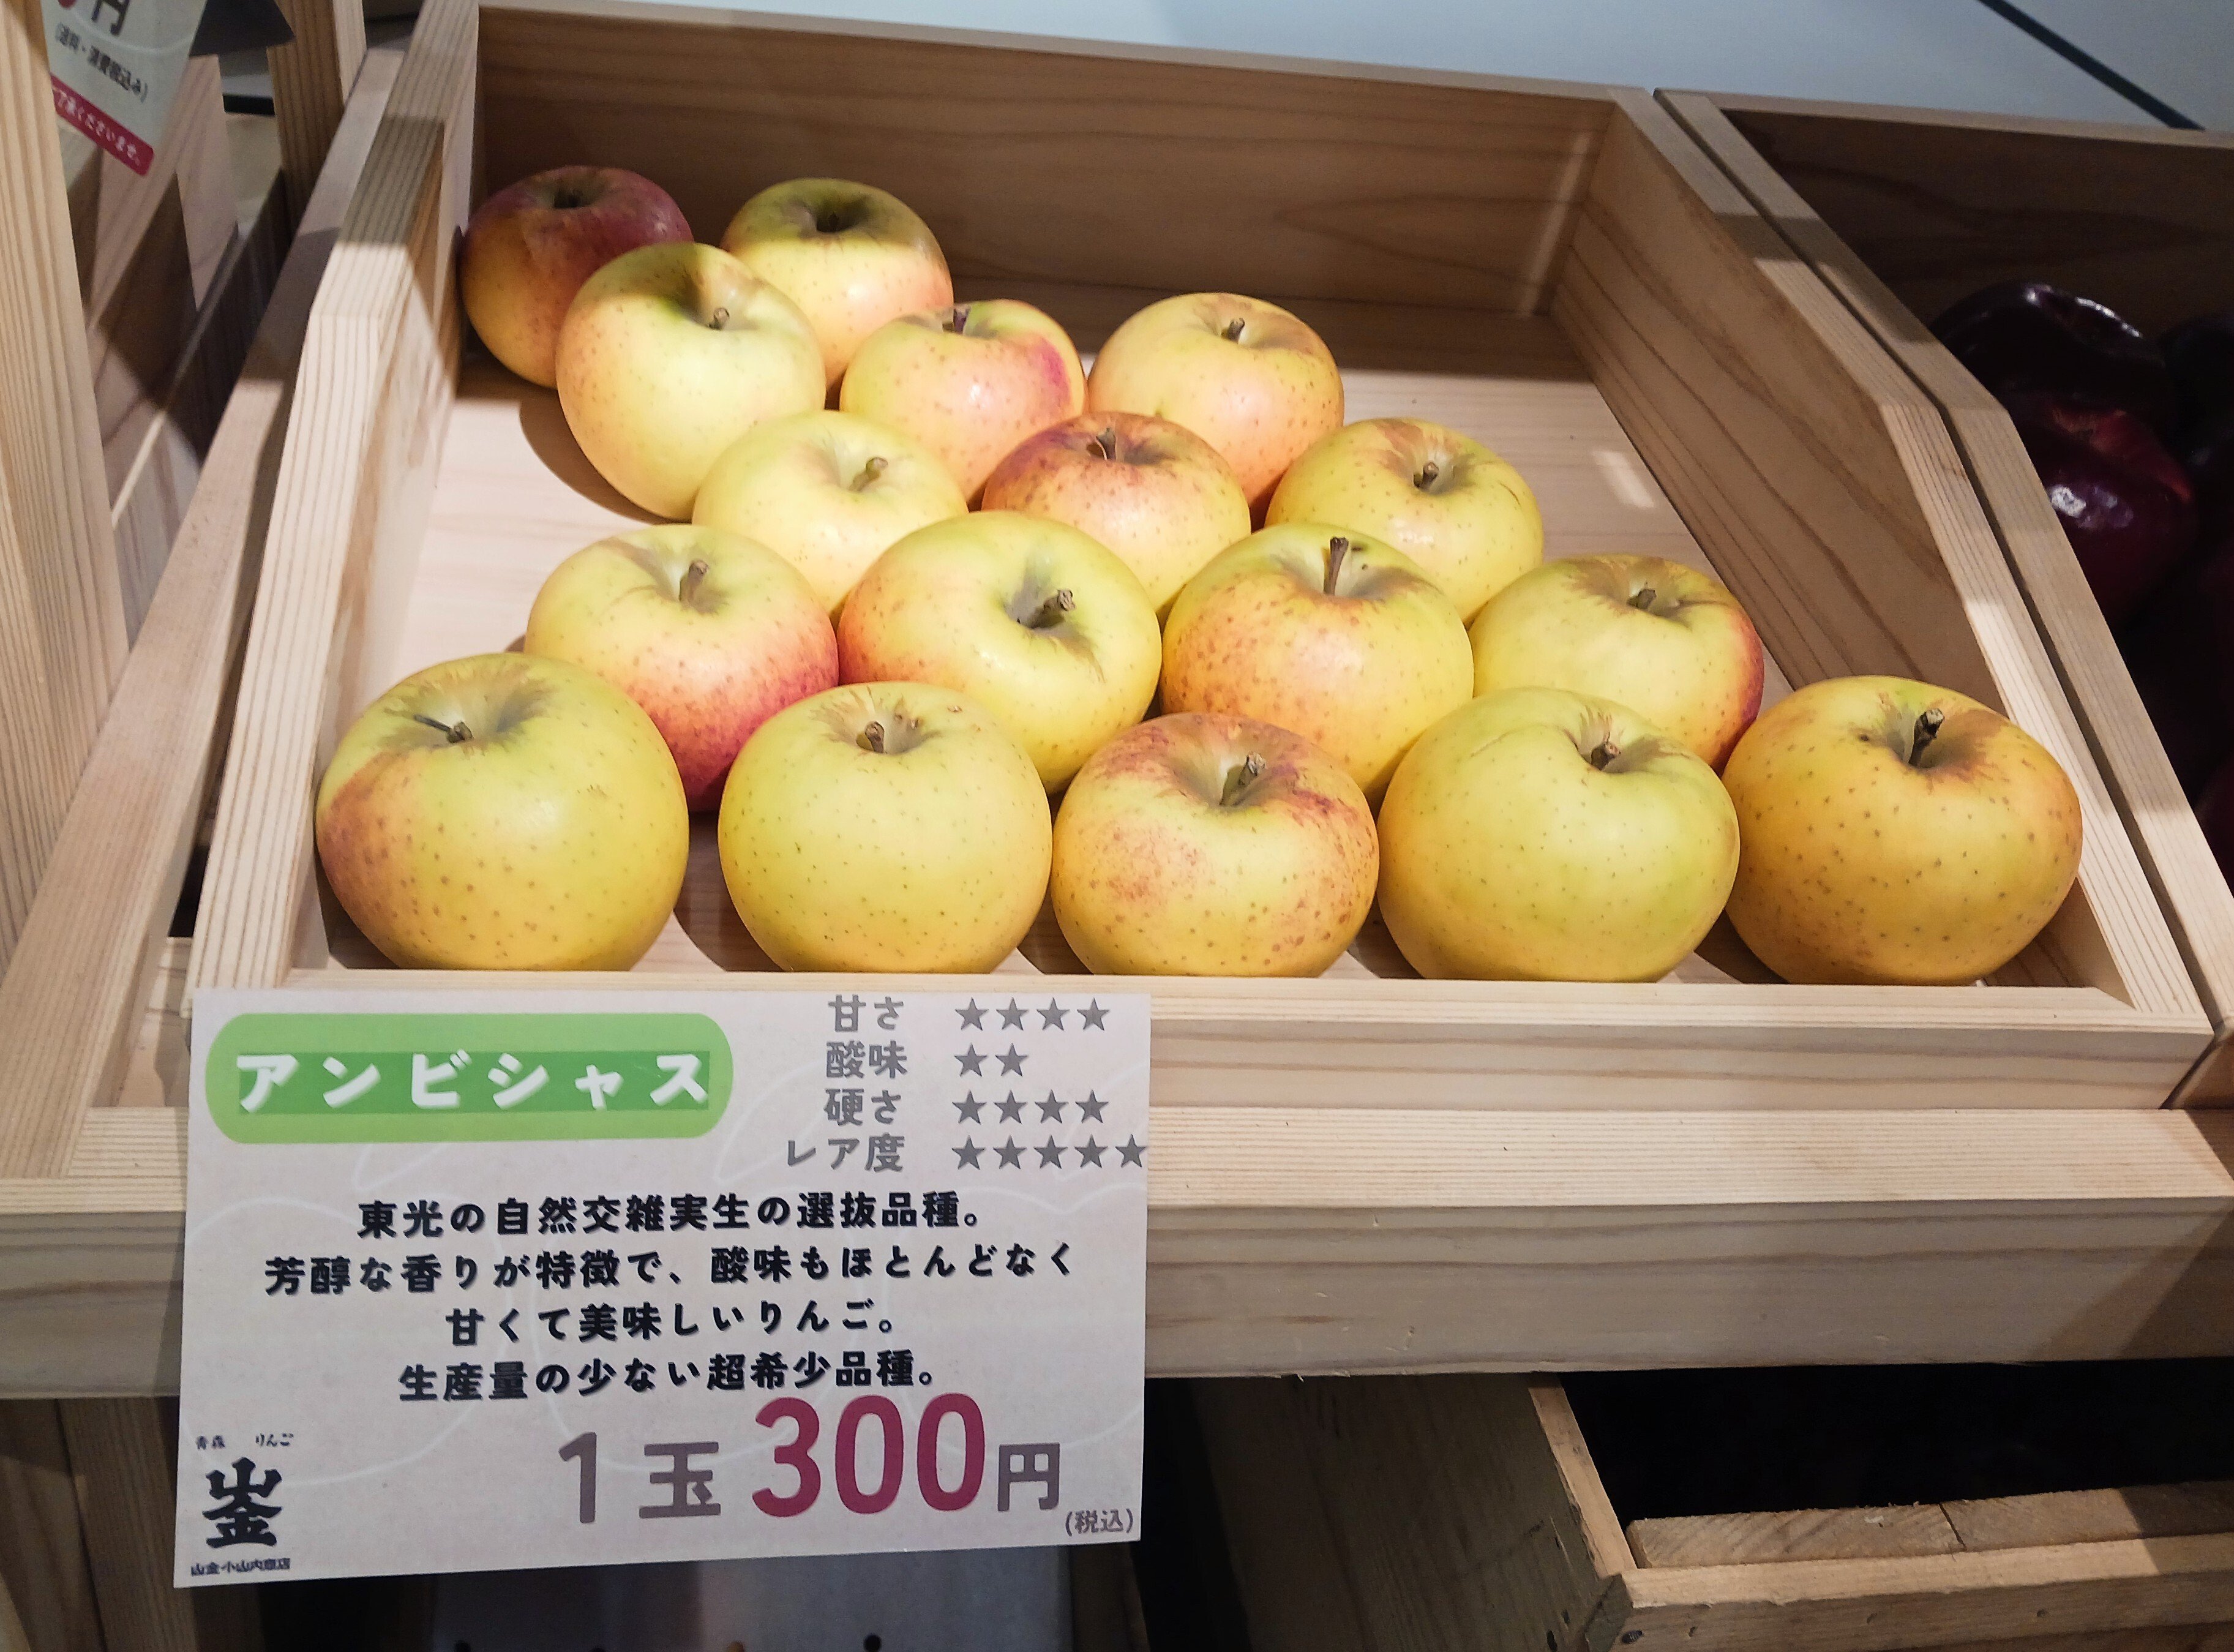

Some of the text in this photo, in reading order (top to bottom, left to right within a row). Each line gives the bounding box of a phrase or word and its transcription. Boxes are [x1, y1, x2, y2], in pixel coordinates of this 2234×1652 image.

[828, 994, 904, 1033] 甘さ
[827, 1040, 907, 1079] 酸味
[236, 1049, 707, 1113] アンビシャス
[823, 1087, 902, 1127] 硬さ
[787, 1133, 905, 1173] レア度
[358, 1190, 978, 1239] 東光の自然交雑実生の選抜品種。
[446, 1298, 893, 1347] 甘くて美味しいりんご。
[399, 1349, 933, 1402] 生産量の少ない超希少品種。
[255, 1433, 294, 1447] りんご
[1065, 1508, 1134, 1537] (税込)
